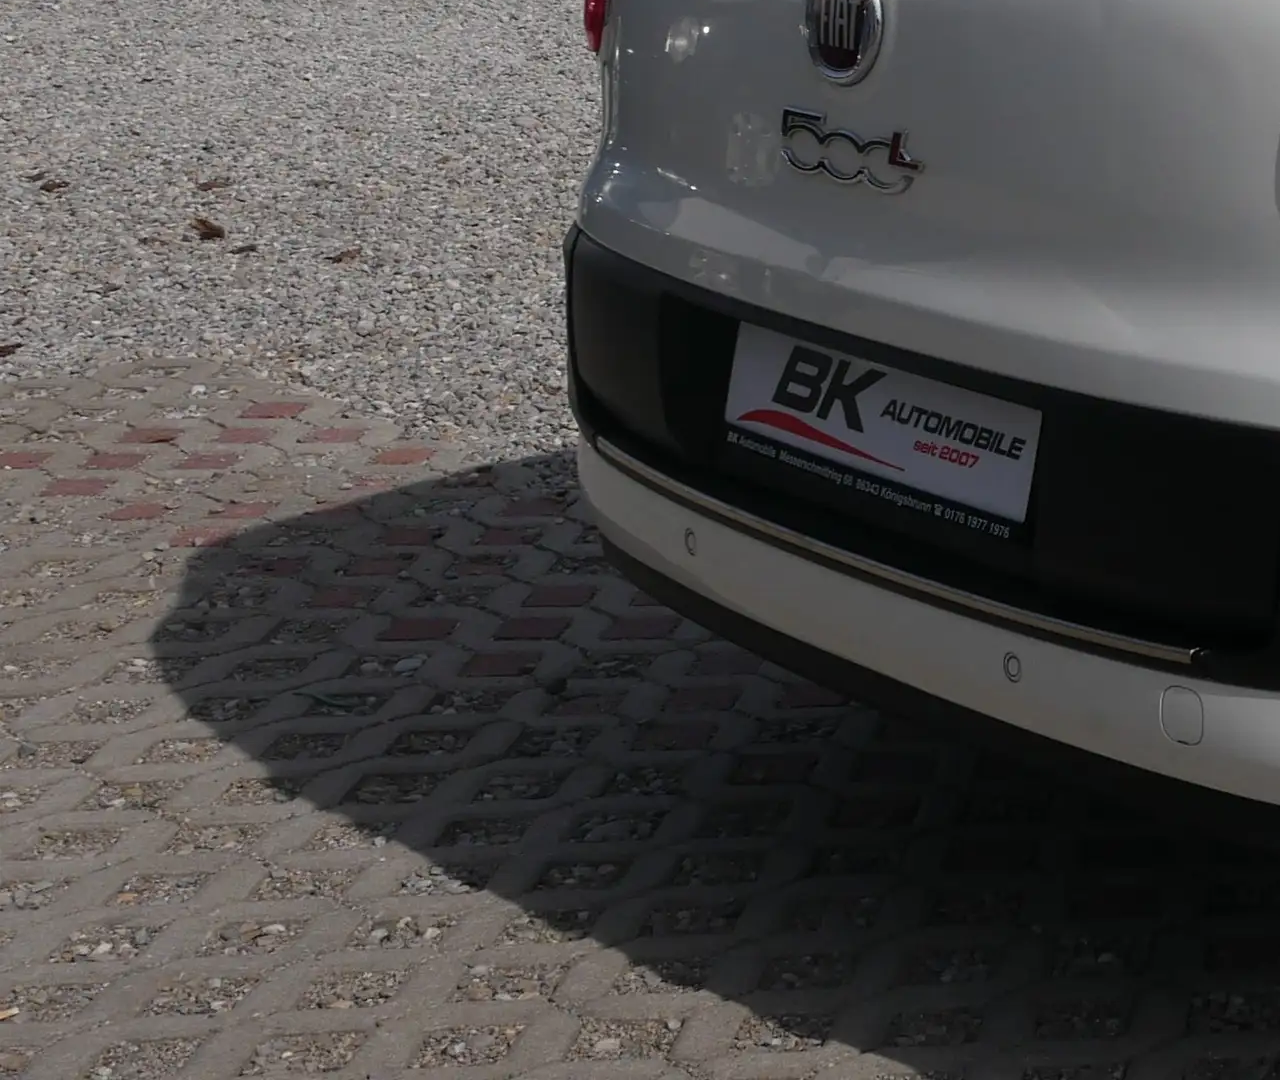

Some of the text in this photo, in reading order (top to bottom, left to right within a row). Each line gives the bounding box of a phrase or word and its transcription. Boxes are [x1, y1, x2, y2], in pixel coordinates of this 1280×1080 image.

[771, 345, 1026, 461] BK AUTOMOBILE
[726, 430, 739, 445] BK
[739, 436, 777, 459] Automobile
[880, 487, 932, 513] Königsbrunn
[913, 439, 980, 469] seit 2007
